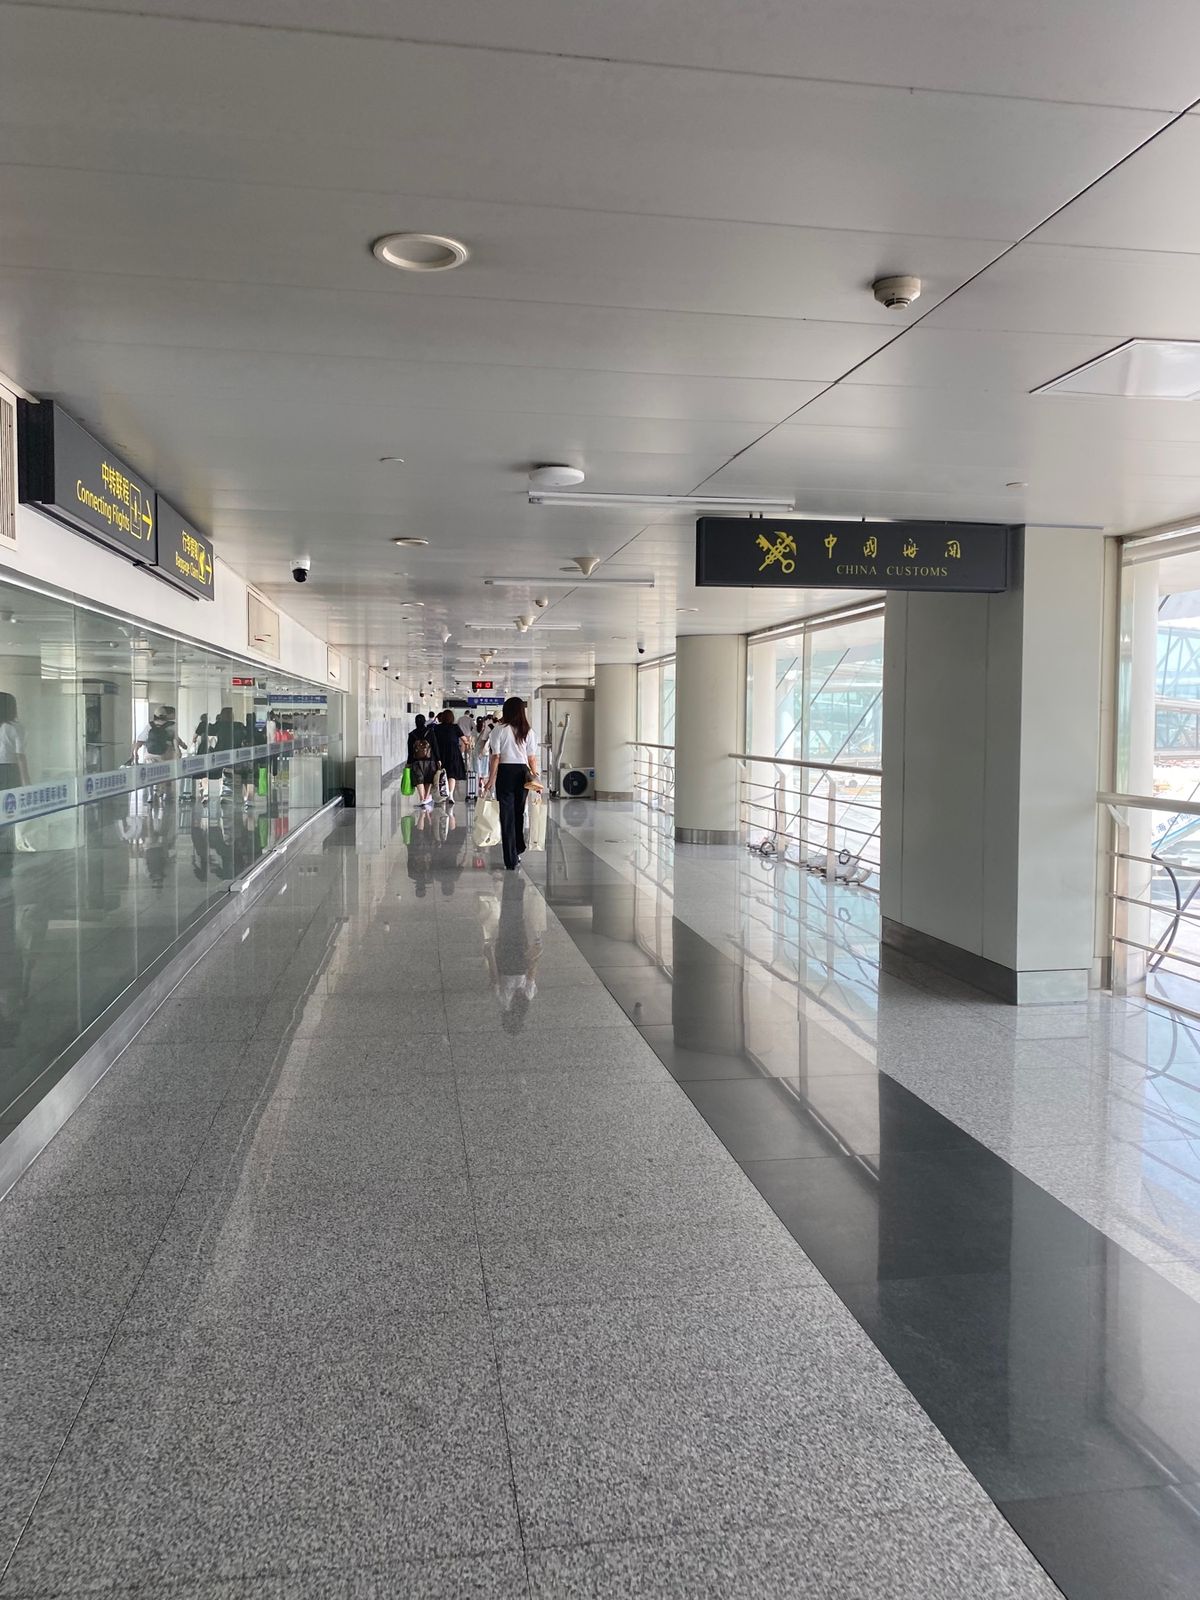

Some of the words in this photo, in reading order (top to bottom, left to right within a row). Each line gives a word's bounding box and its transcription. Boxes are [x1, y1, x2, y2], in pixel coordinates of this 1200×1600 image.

[101, 461, 129, 506] 中转联程
[76, 479, 112, 524] Connecting
[112, 503, 130, 531] Flights
[175, 550, 190, 576] Baggage
[836, 563, 877, 576] CHINA
[886, 565, 949, 577] CUSTOMS
